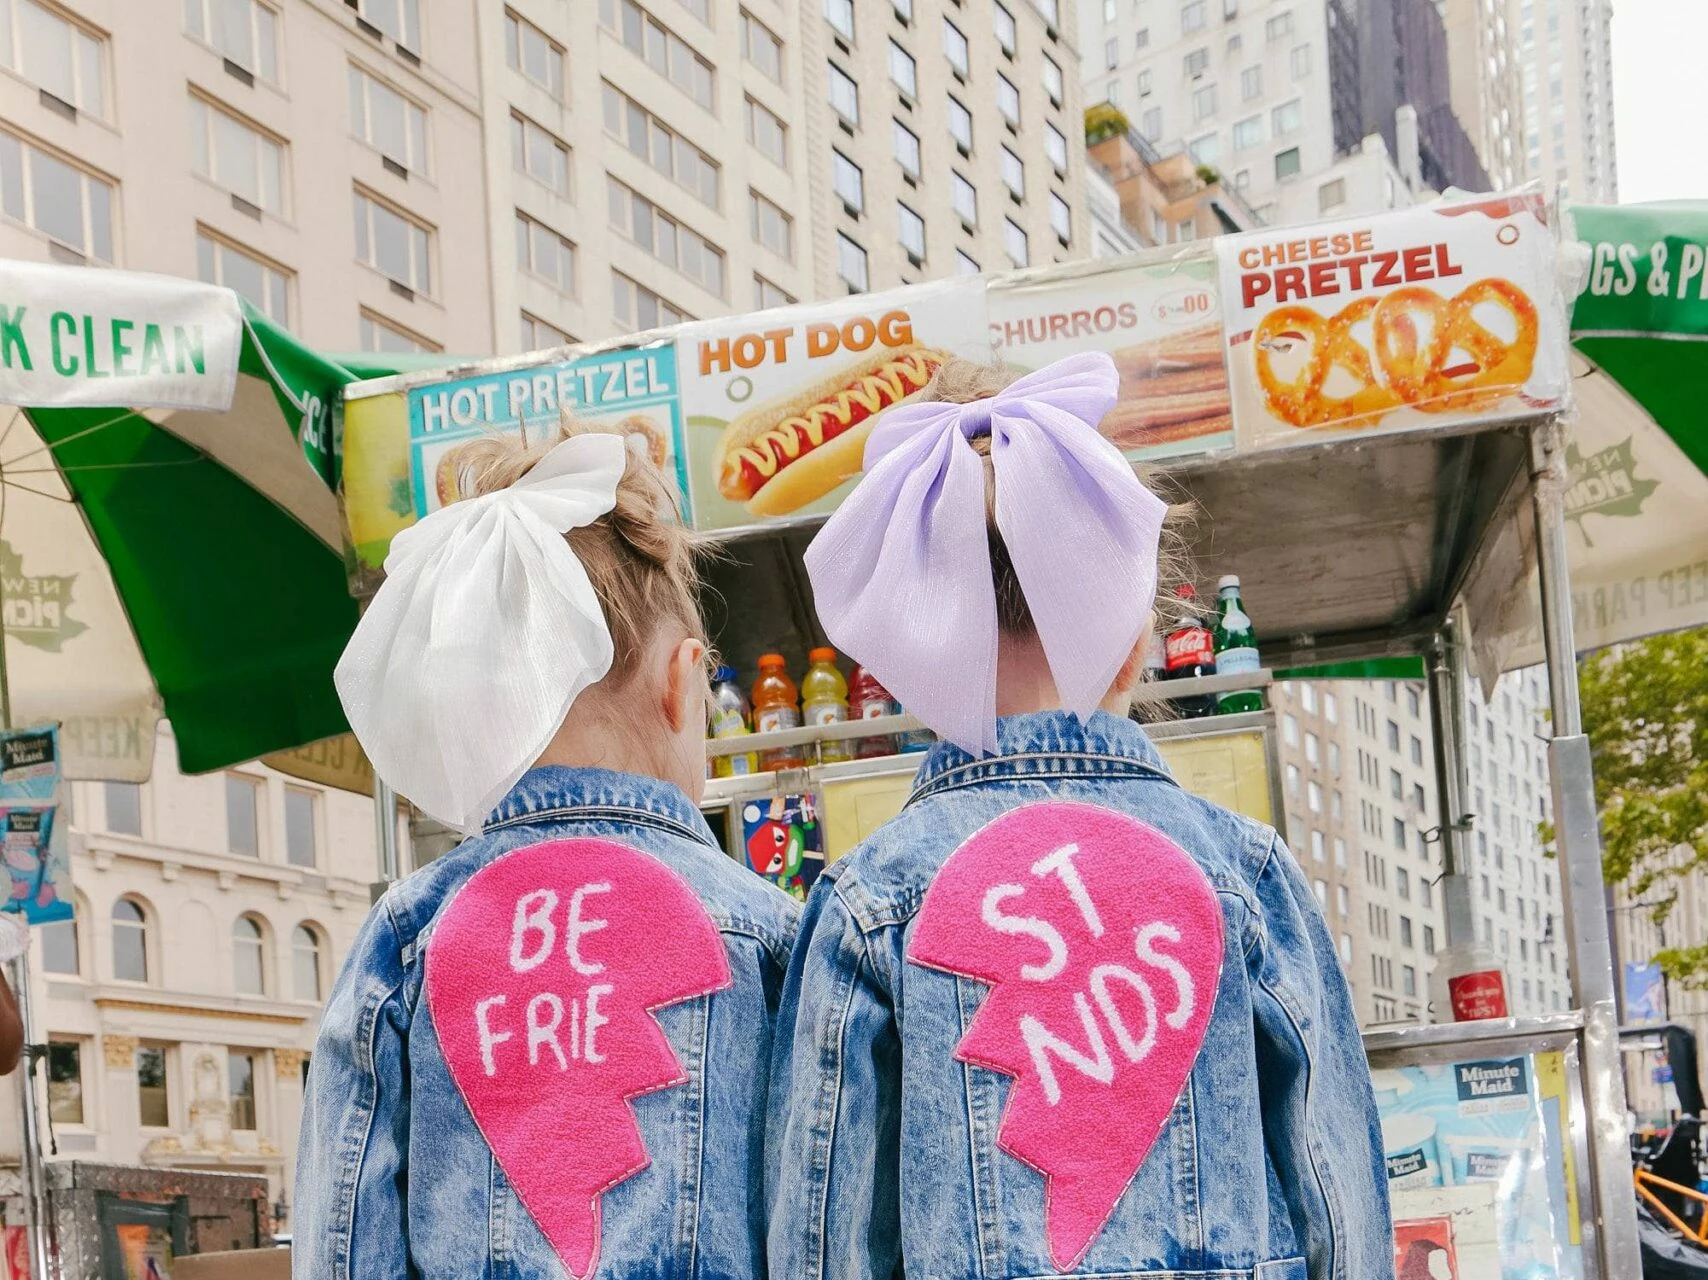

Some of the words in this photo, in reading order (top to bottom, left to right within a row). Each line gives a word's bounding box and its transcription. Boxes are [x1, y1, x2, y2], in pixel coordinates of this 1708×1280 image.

[1238, 229, 1375, 270] CHEESE
[1241, 242, 1463, 309] PRETZEL
[1646, 240, 1670, 297] &
[1676, 243, 1708, 300] P
[49, 311, 207, 379] CLEAN
[699, 326, 794, 376] HOT
[805, 309, 914, 359] DOG
[987, 301, 1139, 350] CHURROS
[421, 383, 500, 433] HOT
[508, 356, 669, 418] PRETZEL
[509, 882, 612, 977] BE
[981, 841, 1105, 982] ST
[474, 984, 614, 1077] FRIE
[1019, 920, 1197, 1106] NDS
[1461, 1065, 1520, 1083] Minute
[1470, 1078, 1514, 1096] Maid
